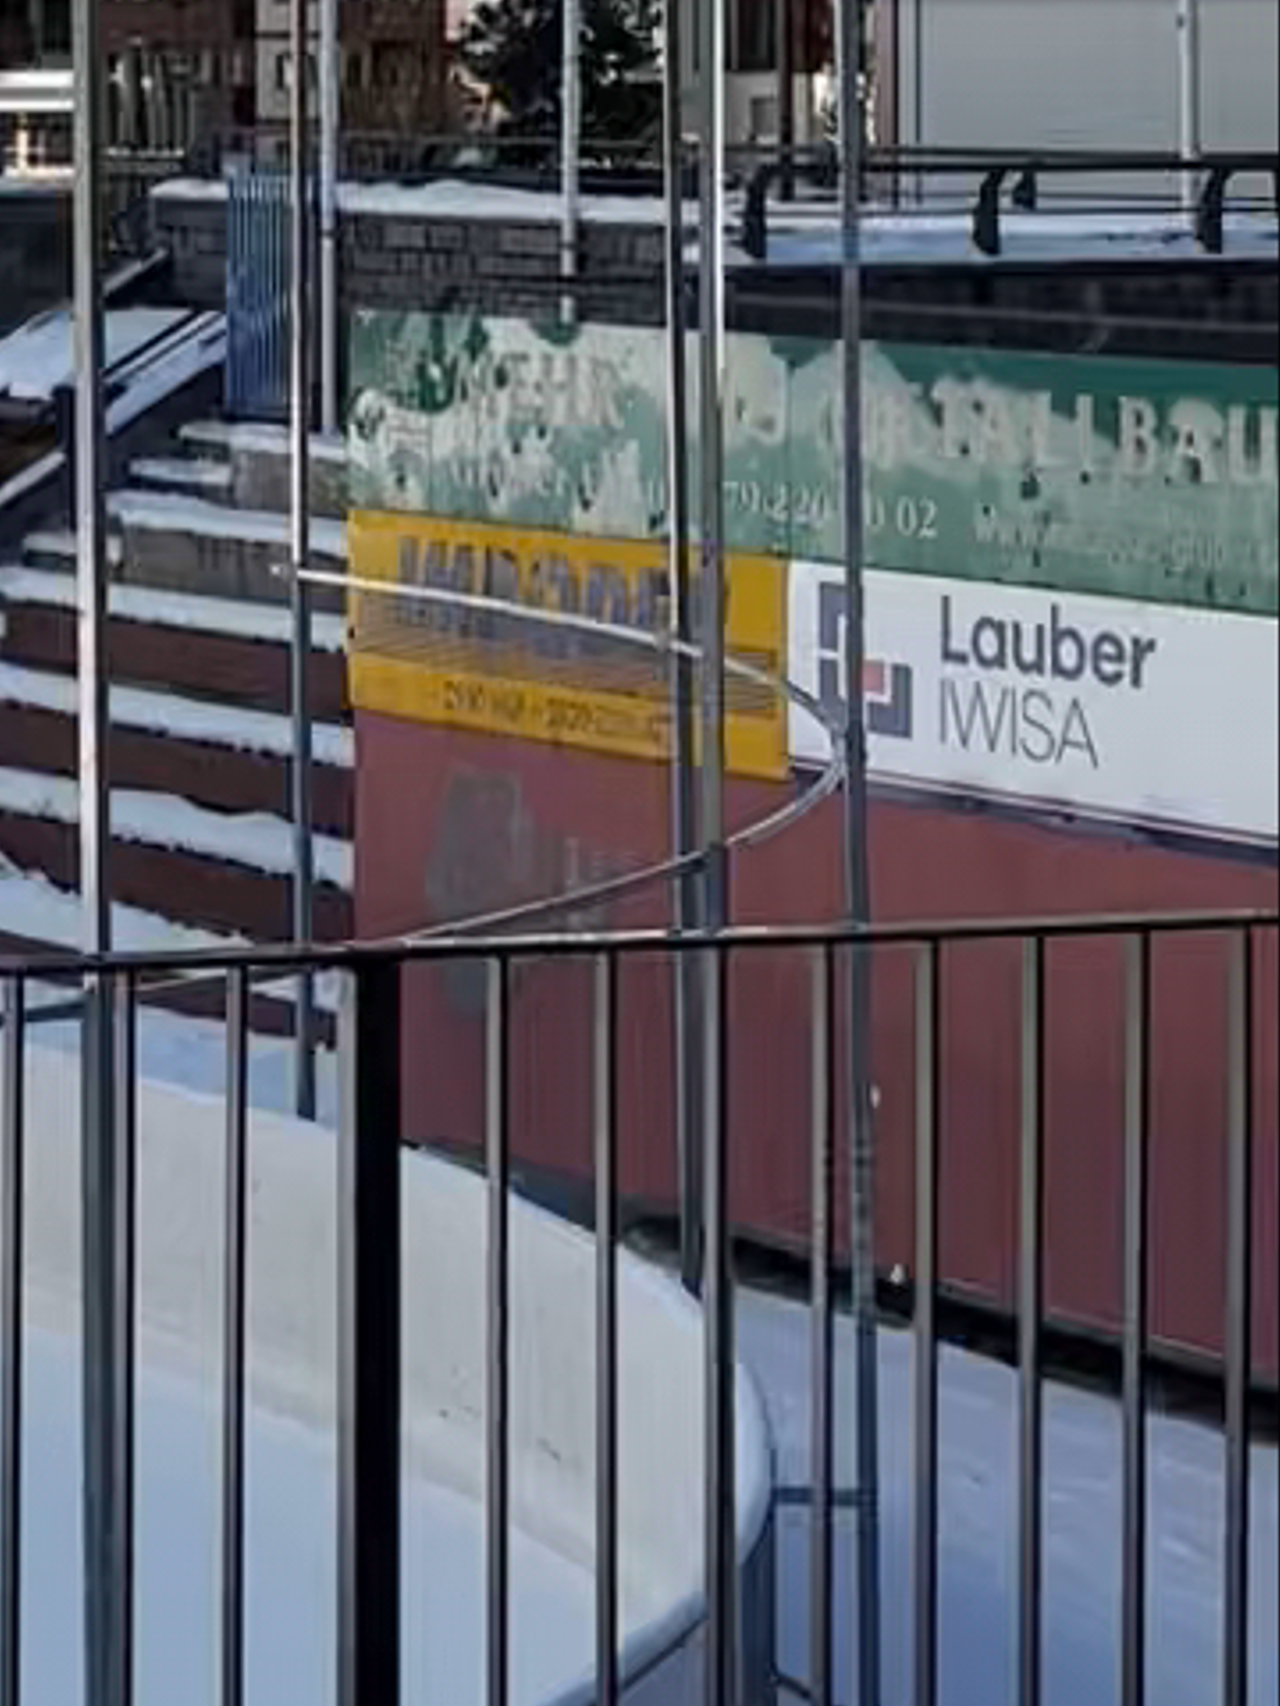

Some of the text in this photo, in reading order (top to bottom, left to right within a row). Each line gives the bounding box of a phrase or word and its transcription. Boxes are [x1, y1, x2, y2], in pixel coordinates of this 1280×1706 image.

[896, 496, 938, 538] 02
[940, 594, 1156, 689] Lauber
[939, 678, 1099, 770] IWISA
